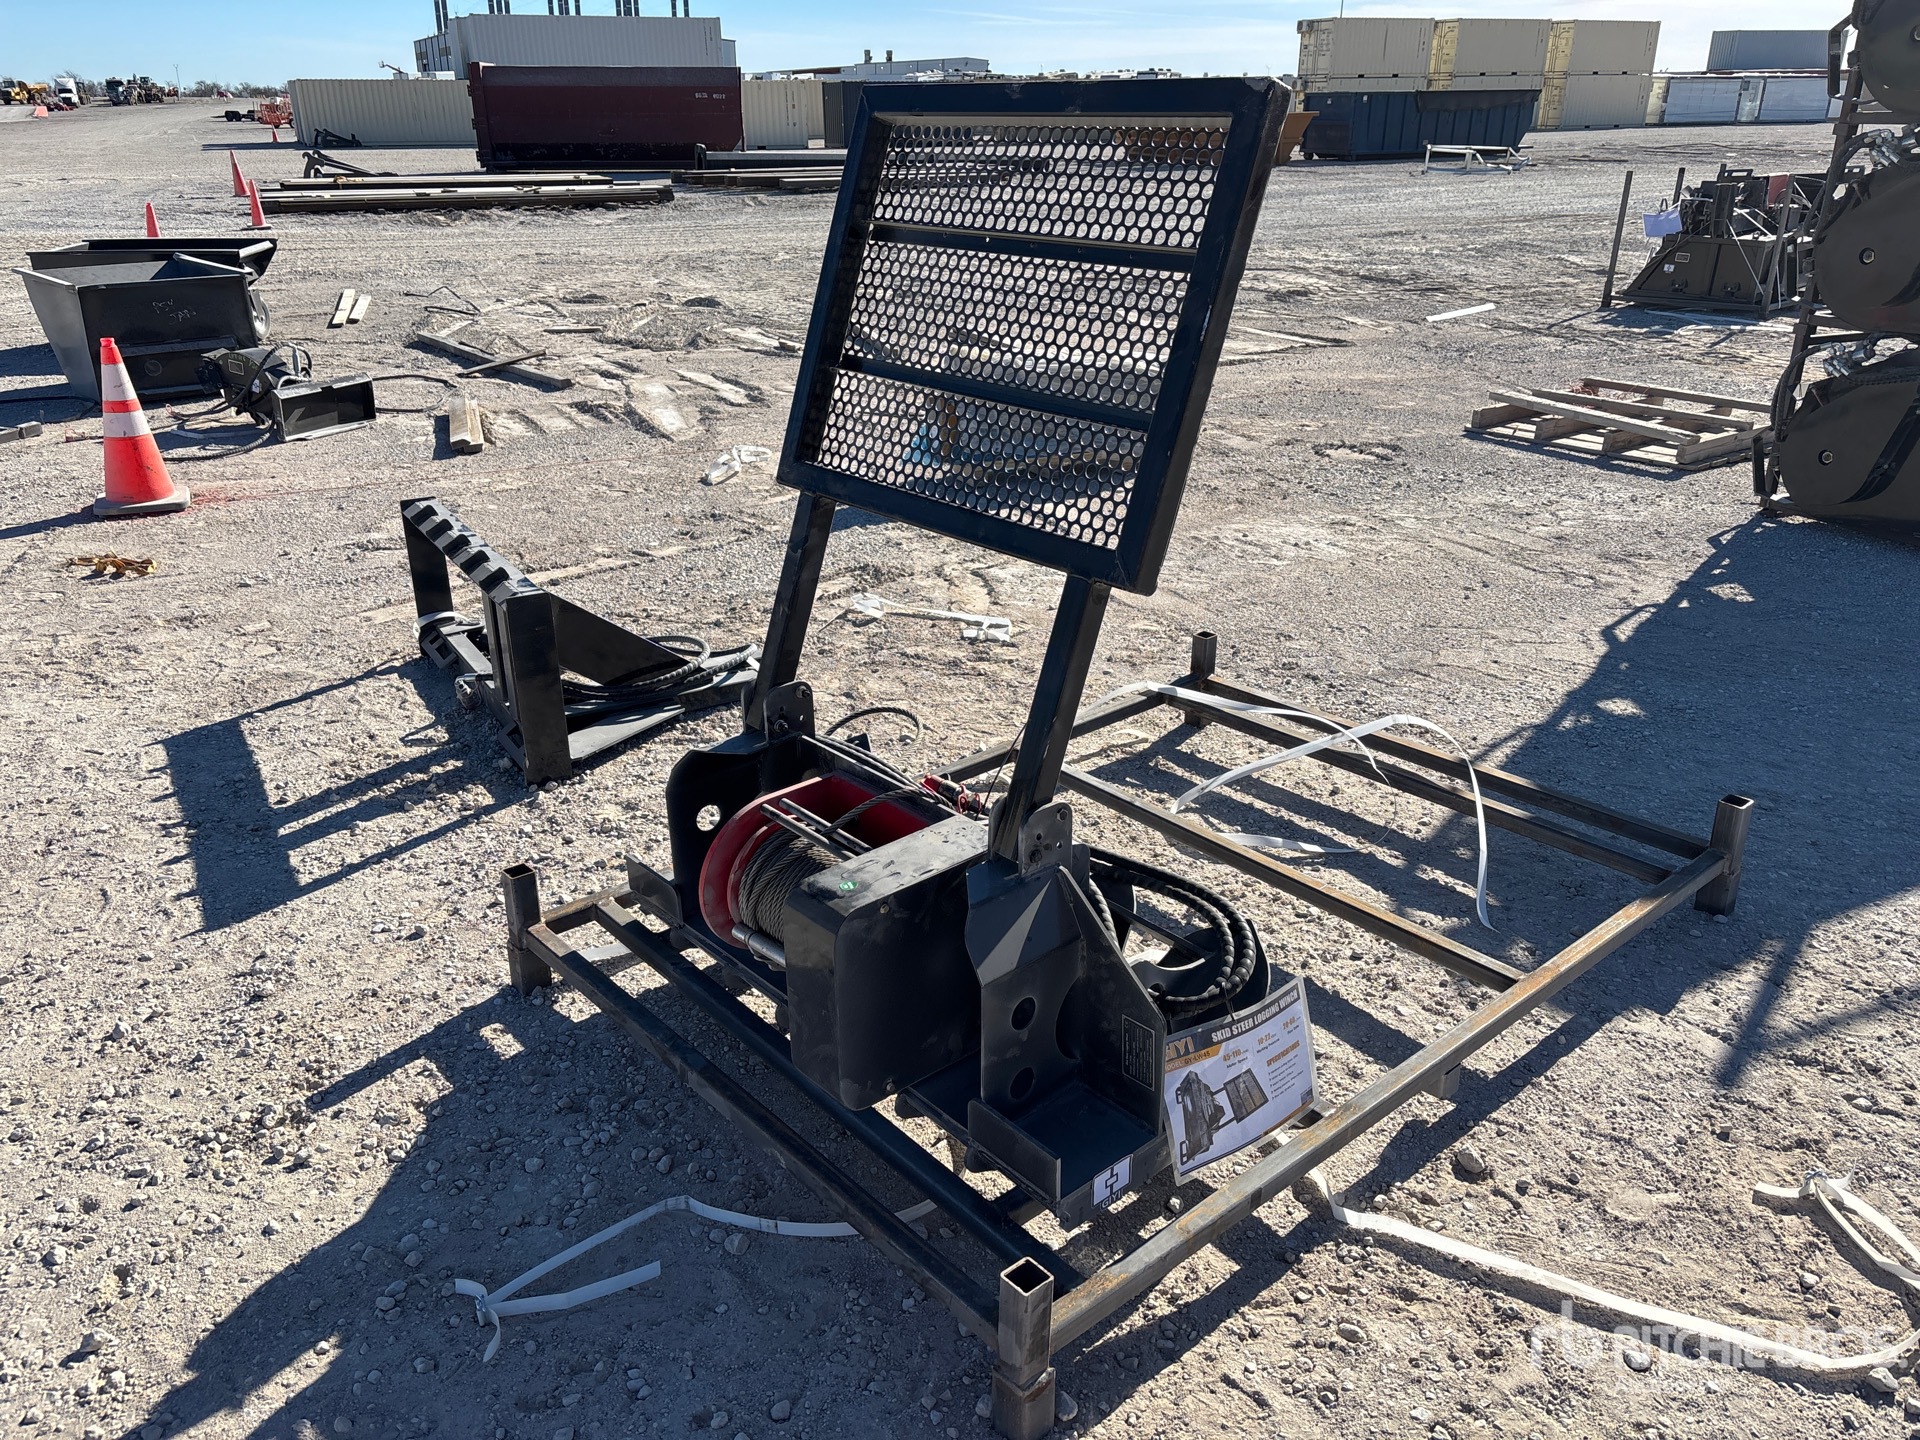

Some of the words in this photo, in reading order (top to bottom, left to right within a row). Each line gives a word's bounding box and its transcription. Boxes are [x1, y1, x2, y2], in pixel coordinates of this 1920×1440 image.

[1211, 1028, 1232, 1043] SKID
[1233, 1018, 1254, 1035] STEER
[1254, 1003, 1280, 1024] LOGGING
[1278, 989, 1298, 1011] WINCH
[1102, 1190, 1121, 1208] GIYI
